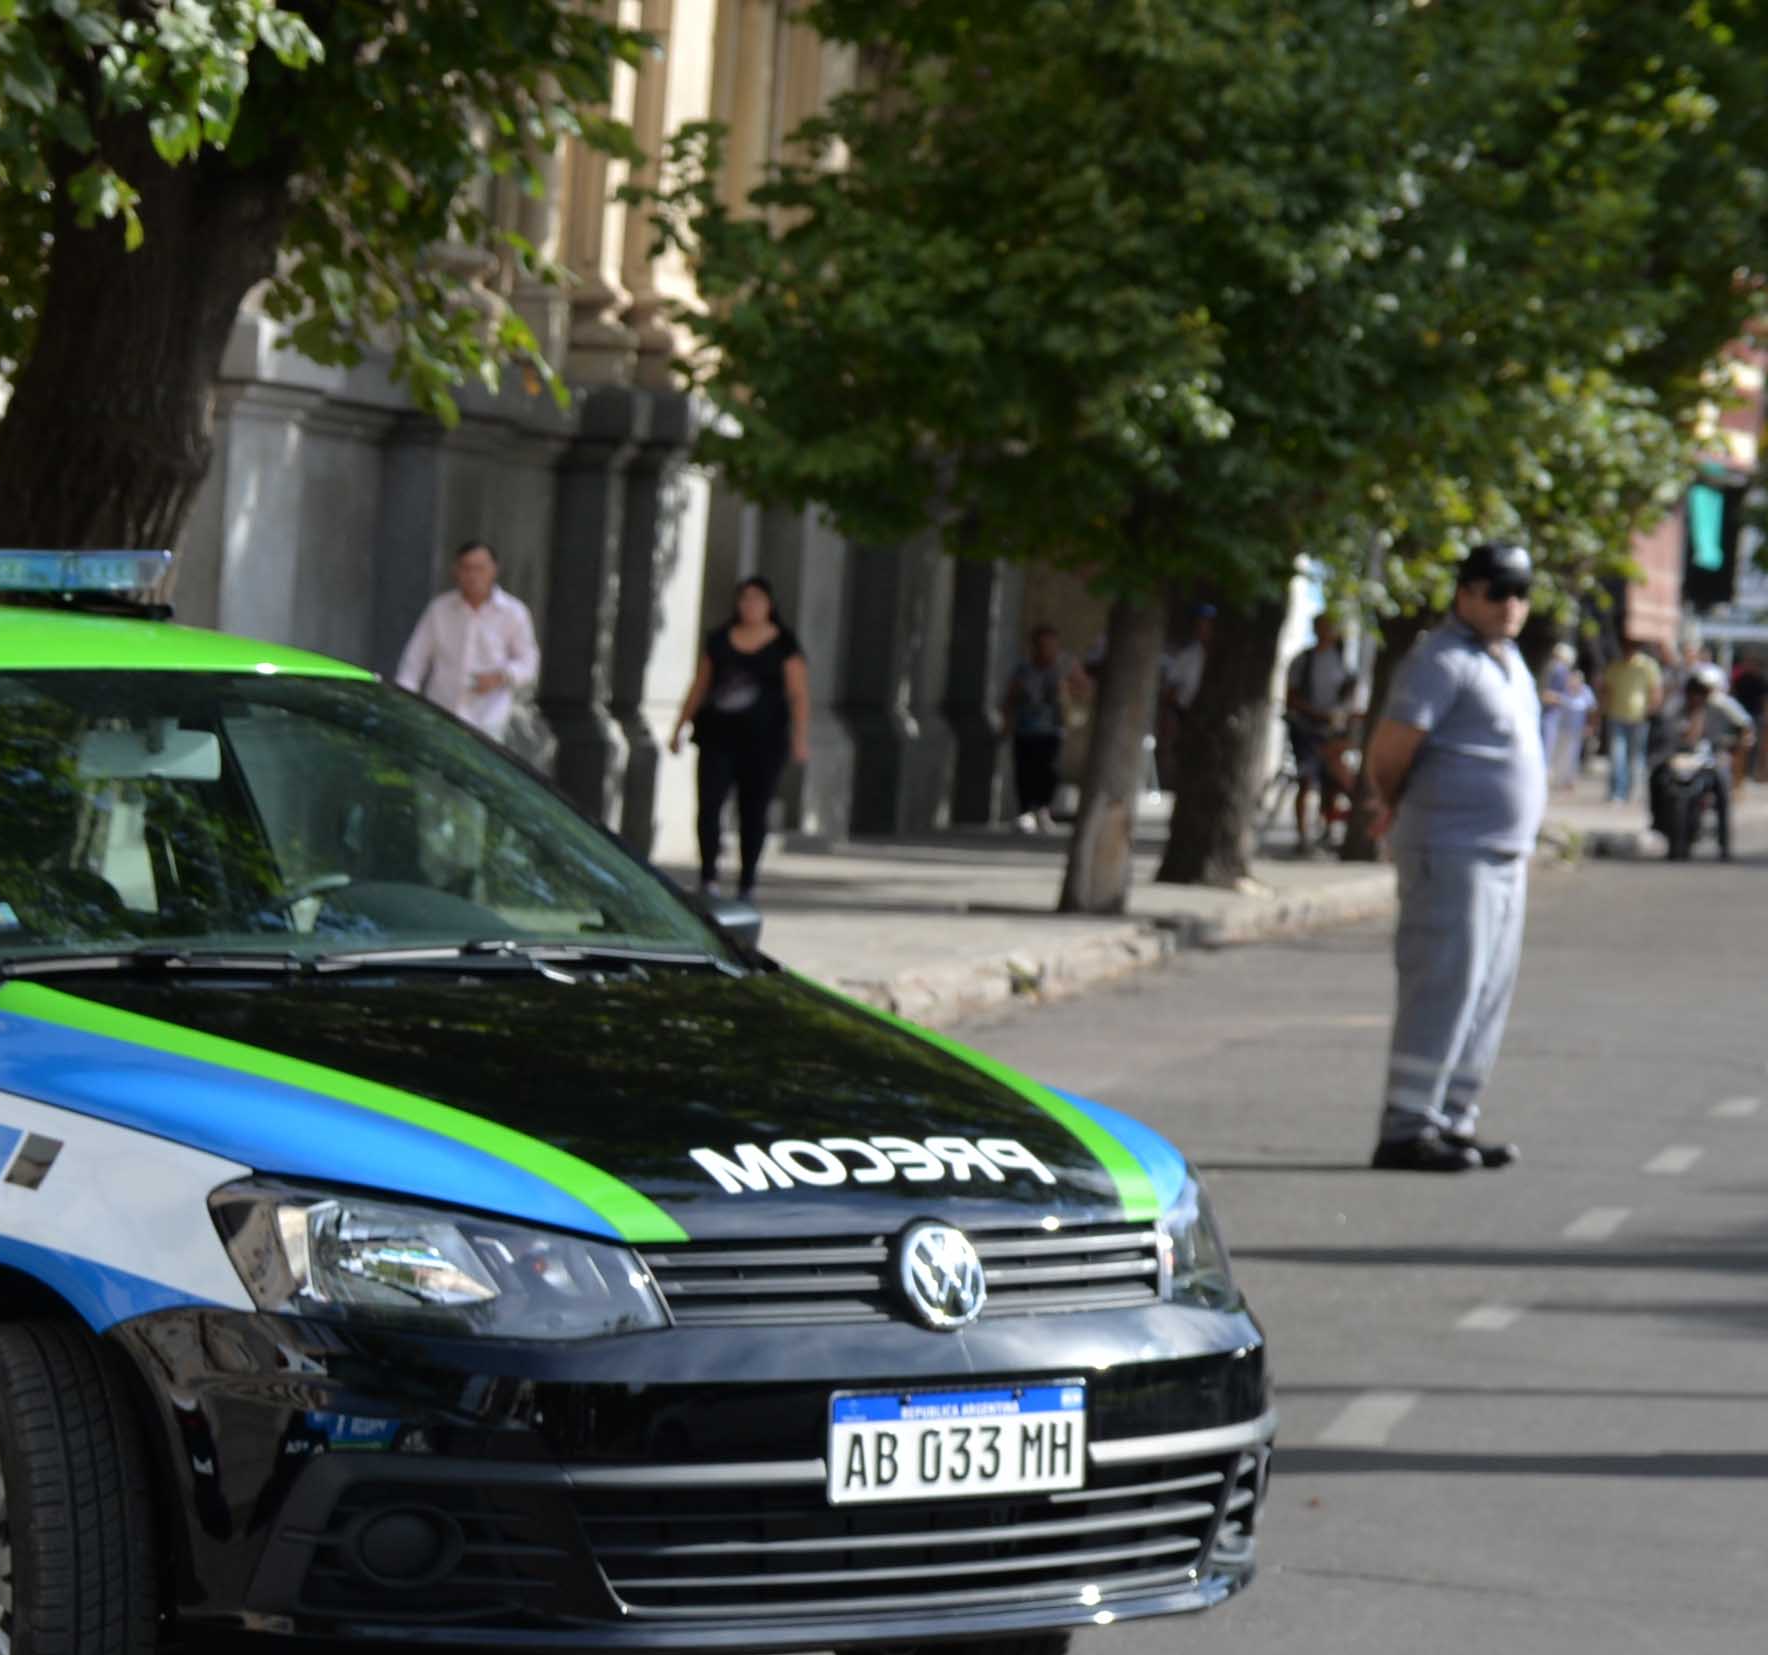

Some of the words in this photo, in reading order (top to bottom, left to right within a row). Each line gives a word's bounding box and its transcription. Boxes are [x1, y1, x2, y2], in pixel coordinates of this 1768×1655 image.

[845, 1431, 898, 1488] AB
[919, 1425, 1002, 1483] 033
[1020, 1421, 1073, 1479] MH
